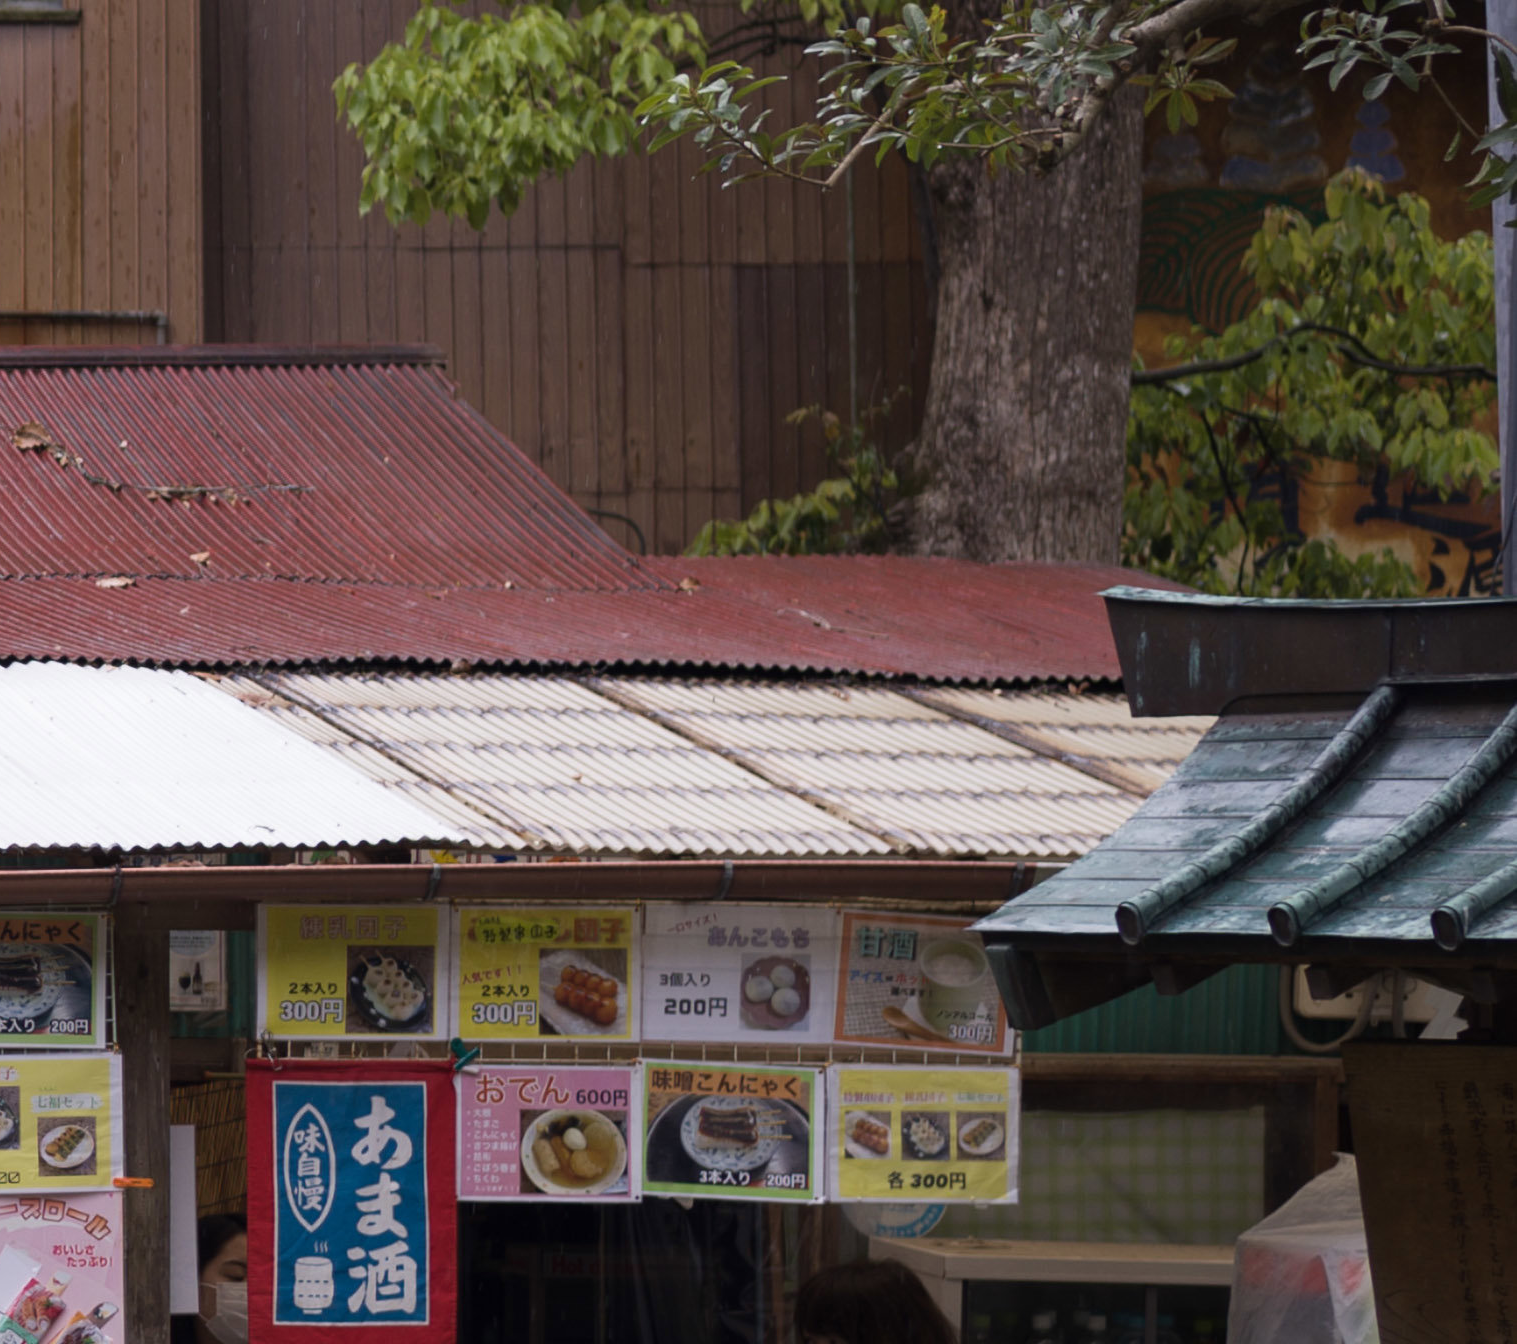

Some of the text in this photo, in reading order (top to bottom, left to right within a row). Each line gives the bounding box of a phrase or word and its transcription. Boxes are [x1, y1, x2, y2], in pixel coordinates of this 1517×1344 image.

[298, 915, 408, 941] 練乳団子
[707, 926, 811, 949] あんこもち
[856, 928, 918, 958] 甘酒
[288, 982, 338, 996] 2本入り
[659, 972, 712, 988] 3個入り
[480, 984, 530, 997] 2本入り
[280, 998, 345, 1024] 300円
[471, 1000, 537, 1026] 300円
[664, 997, 728, 1018] 200円
[936, 1010, 993, 1022] ノンアルコール
[50, 1018, 89, 1035] 200円
[949, 1024, 994, 1043] 300円
[475, 1074, 628, 1106] おでん 600円
[652, 1069, 799, 1097] 味噌こんにゃく
[35, 1093, 101, 1111] 七福セット
[473, 1130, 517, 1140] こんにゃく
[293, 1122, 326, 1212] 味自慢
[473, 1174, 500, 1184] ちくわ
[698, 1169, 807, 1188] 3本入り 200円
[887, 1171, 966, 1191] 各 300円
[345, 1094, 418, 1315] あま酒
[52, 1244, 96, 1256] おいしさ
[66, 1255, 114, 1269] たっぷり!
